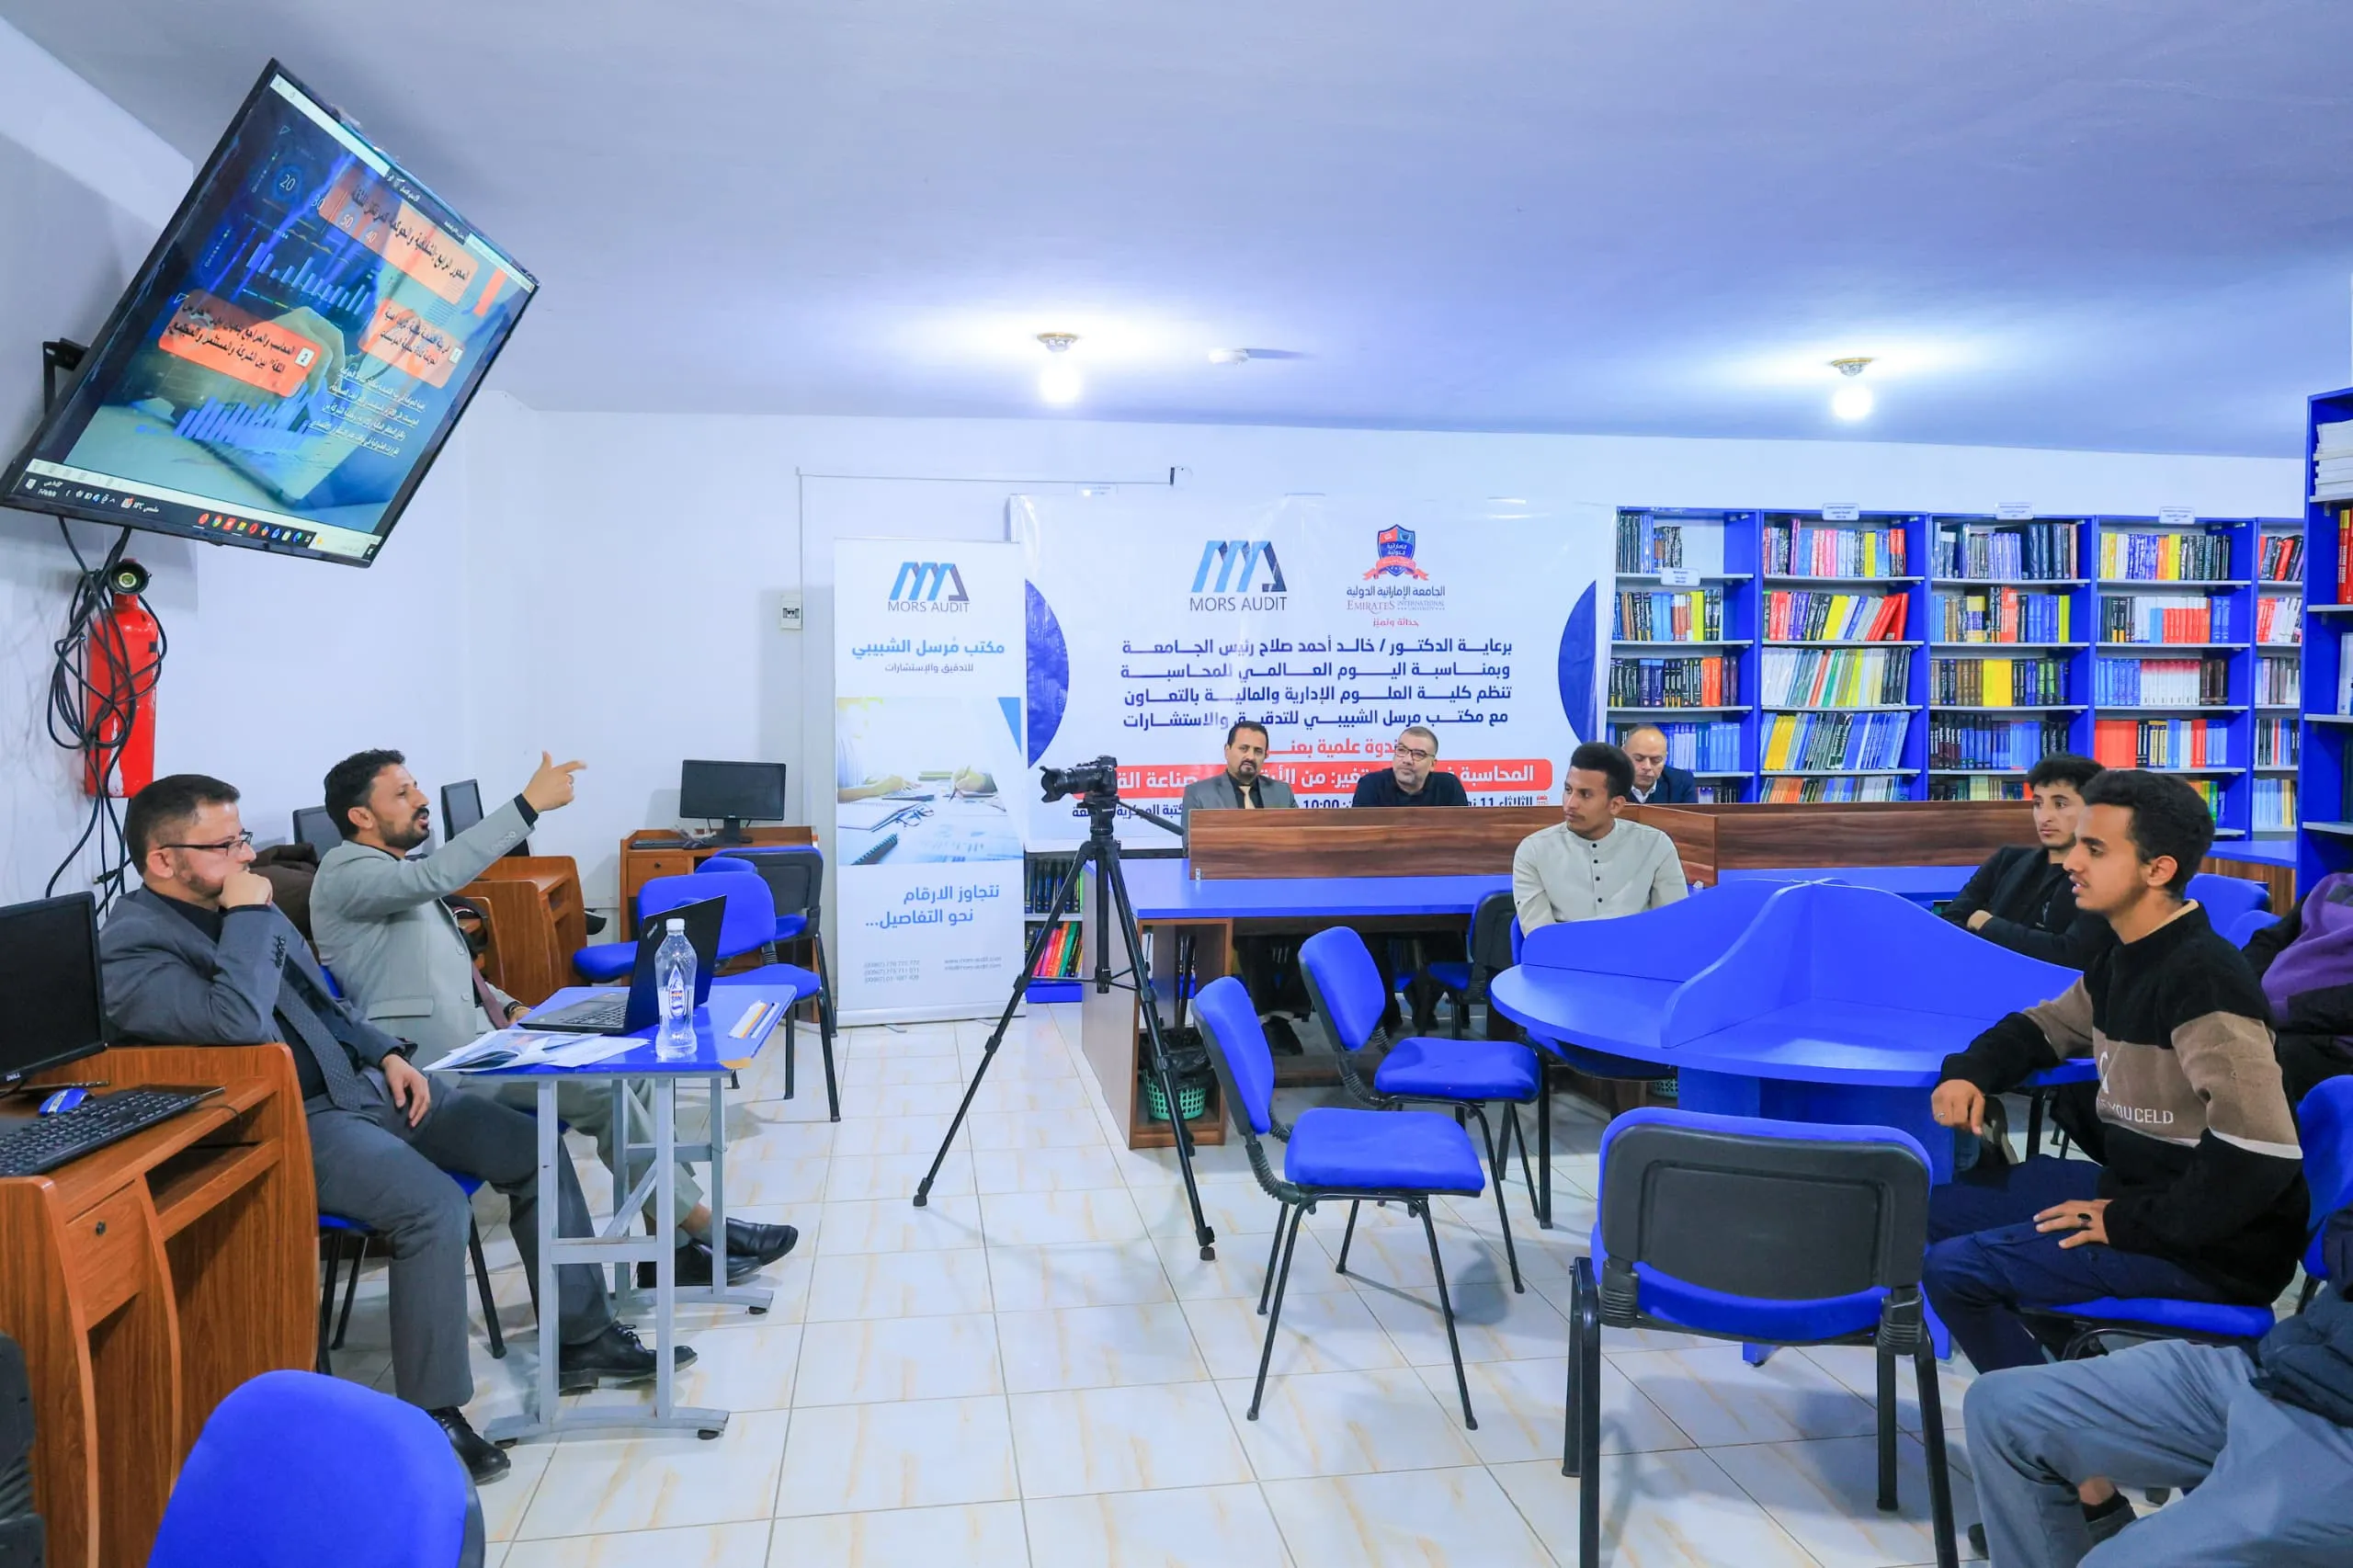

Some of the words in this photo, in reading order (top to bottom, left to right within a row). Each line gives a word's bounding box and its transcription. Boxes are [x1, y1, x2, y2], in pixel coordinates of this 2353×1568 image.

[279, 174, 296, 191] 20
[340, 214, 354, 228] 50
[366, 231, 378, 244] 40
[301, 351, 308, 363] 2
[1347, 585, 1376, 598] الدولية
[1377, 585, 1411, 600] الإماراتية
[1413, 585, 1445, 597] الجامعة
[888, 601, 926, 612] MORS
[931, 601, 970, 613] AUDIT
[1189, 597, 1236, 611] MORS
[1241, 597, 1287, 611] AUDIT
[852, 637, 910, 660] الشبيبي
[964, 640, 1005, 656] مكتب
[1122, 639, 1213, 657] الجامعة
[1219, 638, 1255, 656] رئيس
[1258, 638, 1293, 656] صلاح
[1298, 635, 1331, 653] أحمد
[1336, 638, 1374, 653] خالد
[1380, 638, 1385, 653] /
[1389, 638, 1452, 656] الدكتور
[1458, 638, 1512, 656] برعاية
[1120, 663, 1233, 682] للمحاسبة
[1238, 662, 1332, 683] العالمي
[1337, 662, 1406, 680] اليوم
[1411, 662, 1510, 680] وبمناسبة
[1124, 687, 1199, 707] بالتعاون
[1204, 687, 1279, 705] والمالية
[1285, 686, 1335, 705] الإدارية
[1340, 686, 1412, 704] العلوم
[1417, 685, 1472, 703] كلية
[1476, 686, 1512, 703] تنظم
[1123, 711, 1229, 731] والاستشارات
[1303, 709, 1378, 731] الشبيبي
[1382, 710, 1421, 727] مرسل
[1426, 710, 1483, 727] مكتب
[1489, 712, 1508, 726] مع
[1317, 737, 1360, 758] علمية
[1301, 770, 1326, 788] من
[1461, 765, 1534, 787] المحاسبة
[904, 886, 953, 905] الارقام
[958, 884, 999, 903] نتجاوز
[949, 908, 973, 926] نحو
